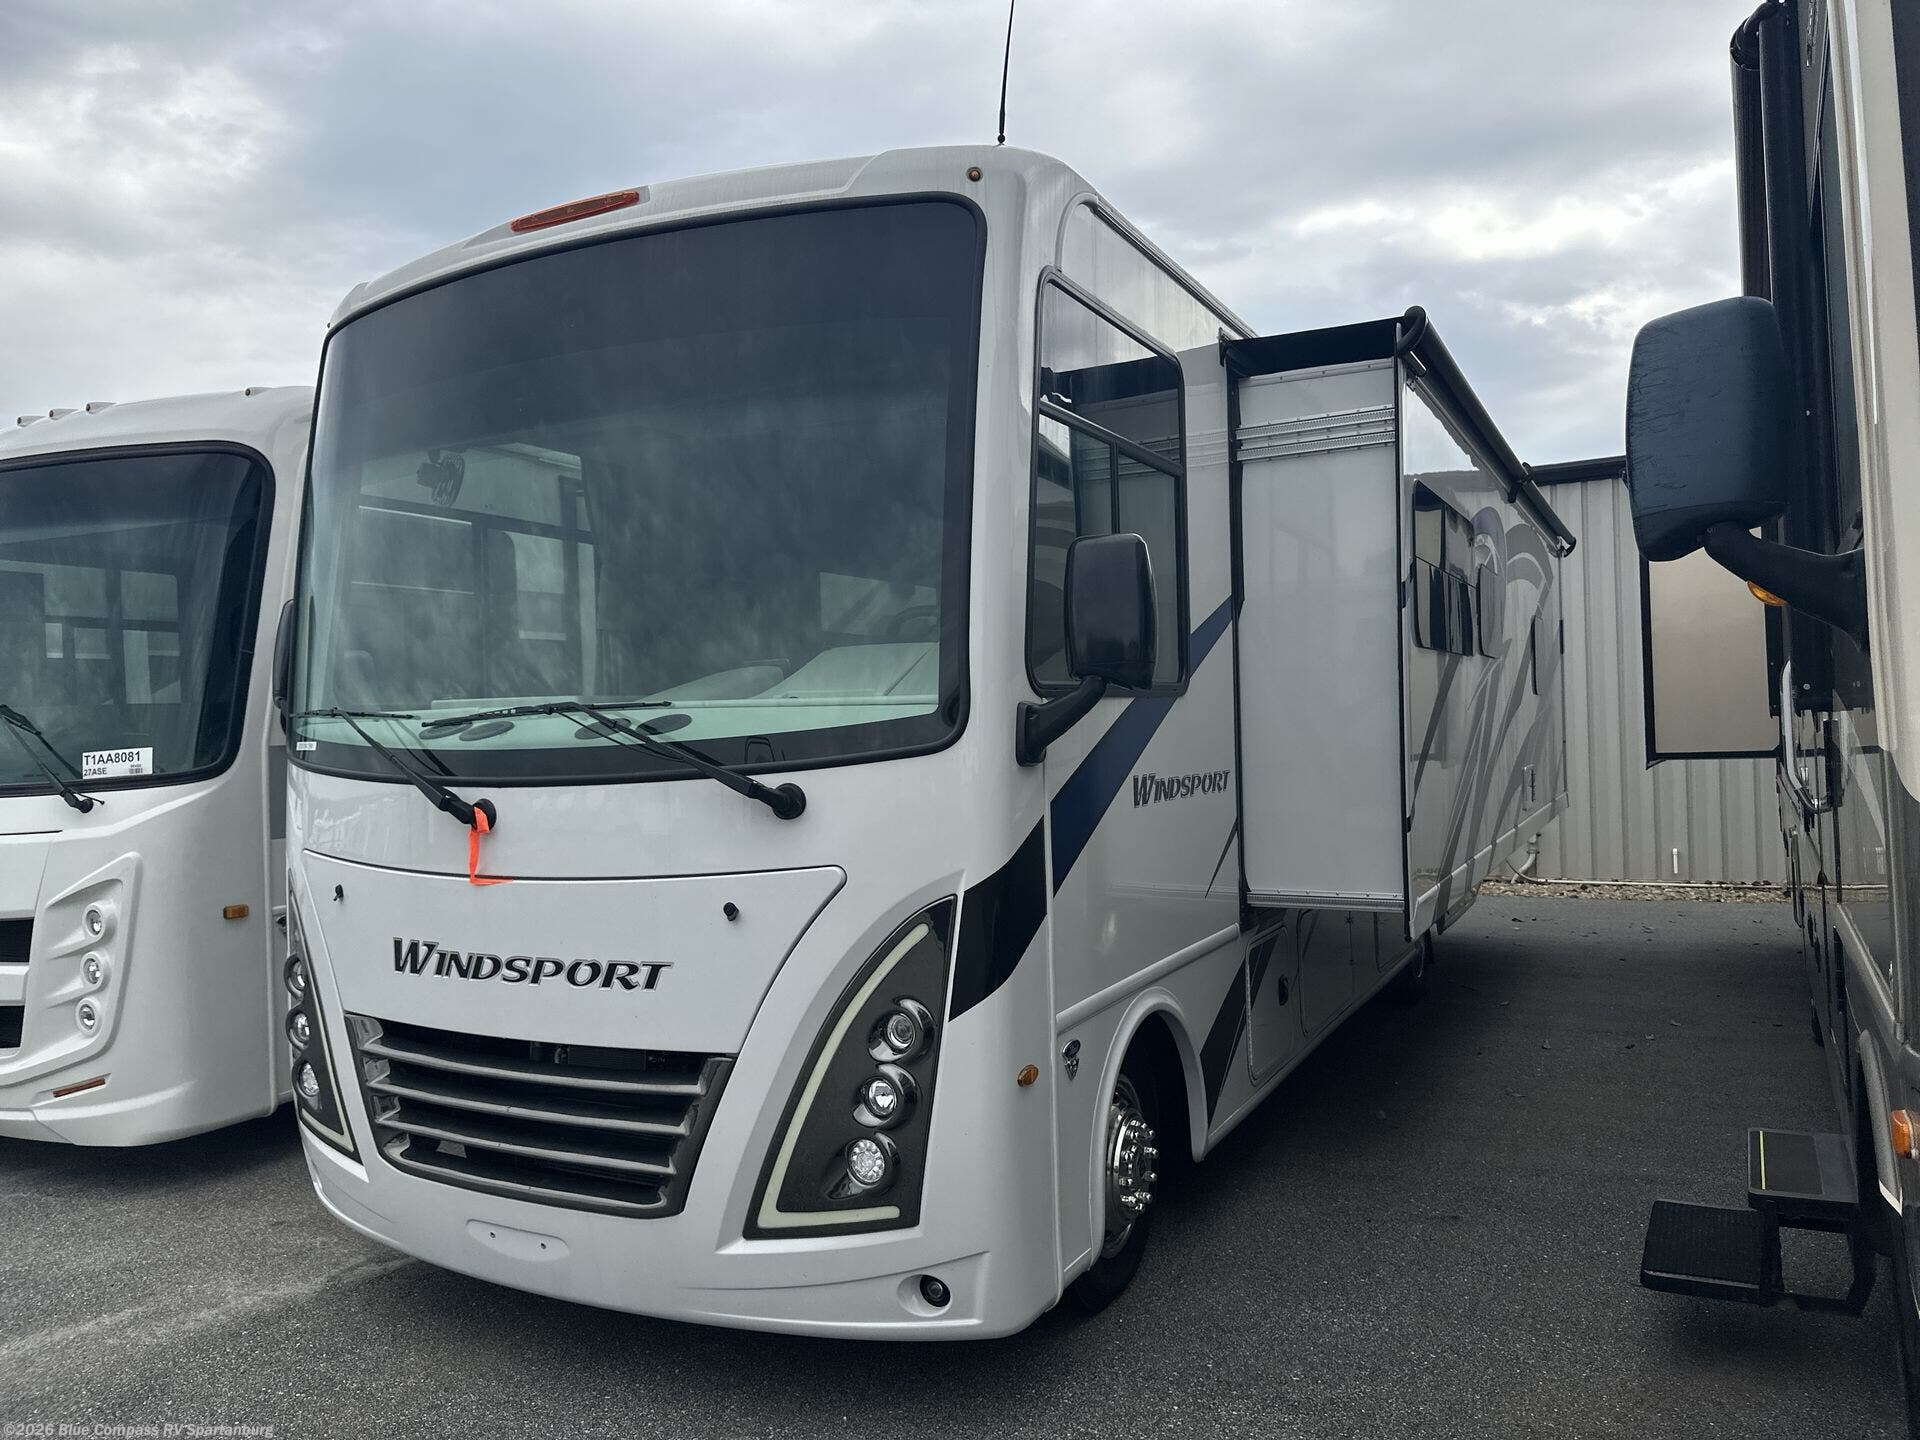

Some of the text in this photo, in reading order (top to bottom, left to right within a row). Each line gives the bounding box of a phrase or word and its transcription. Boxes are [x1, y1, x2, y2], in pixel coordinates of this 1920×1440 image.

[84, 751, 140, 765] T1AA8081
[83, 767, 107, 776] 27ASE
[1132, 770, 1231, 808] WINDSPORT
[393, 936, 675, 992] WINDSPORT
